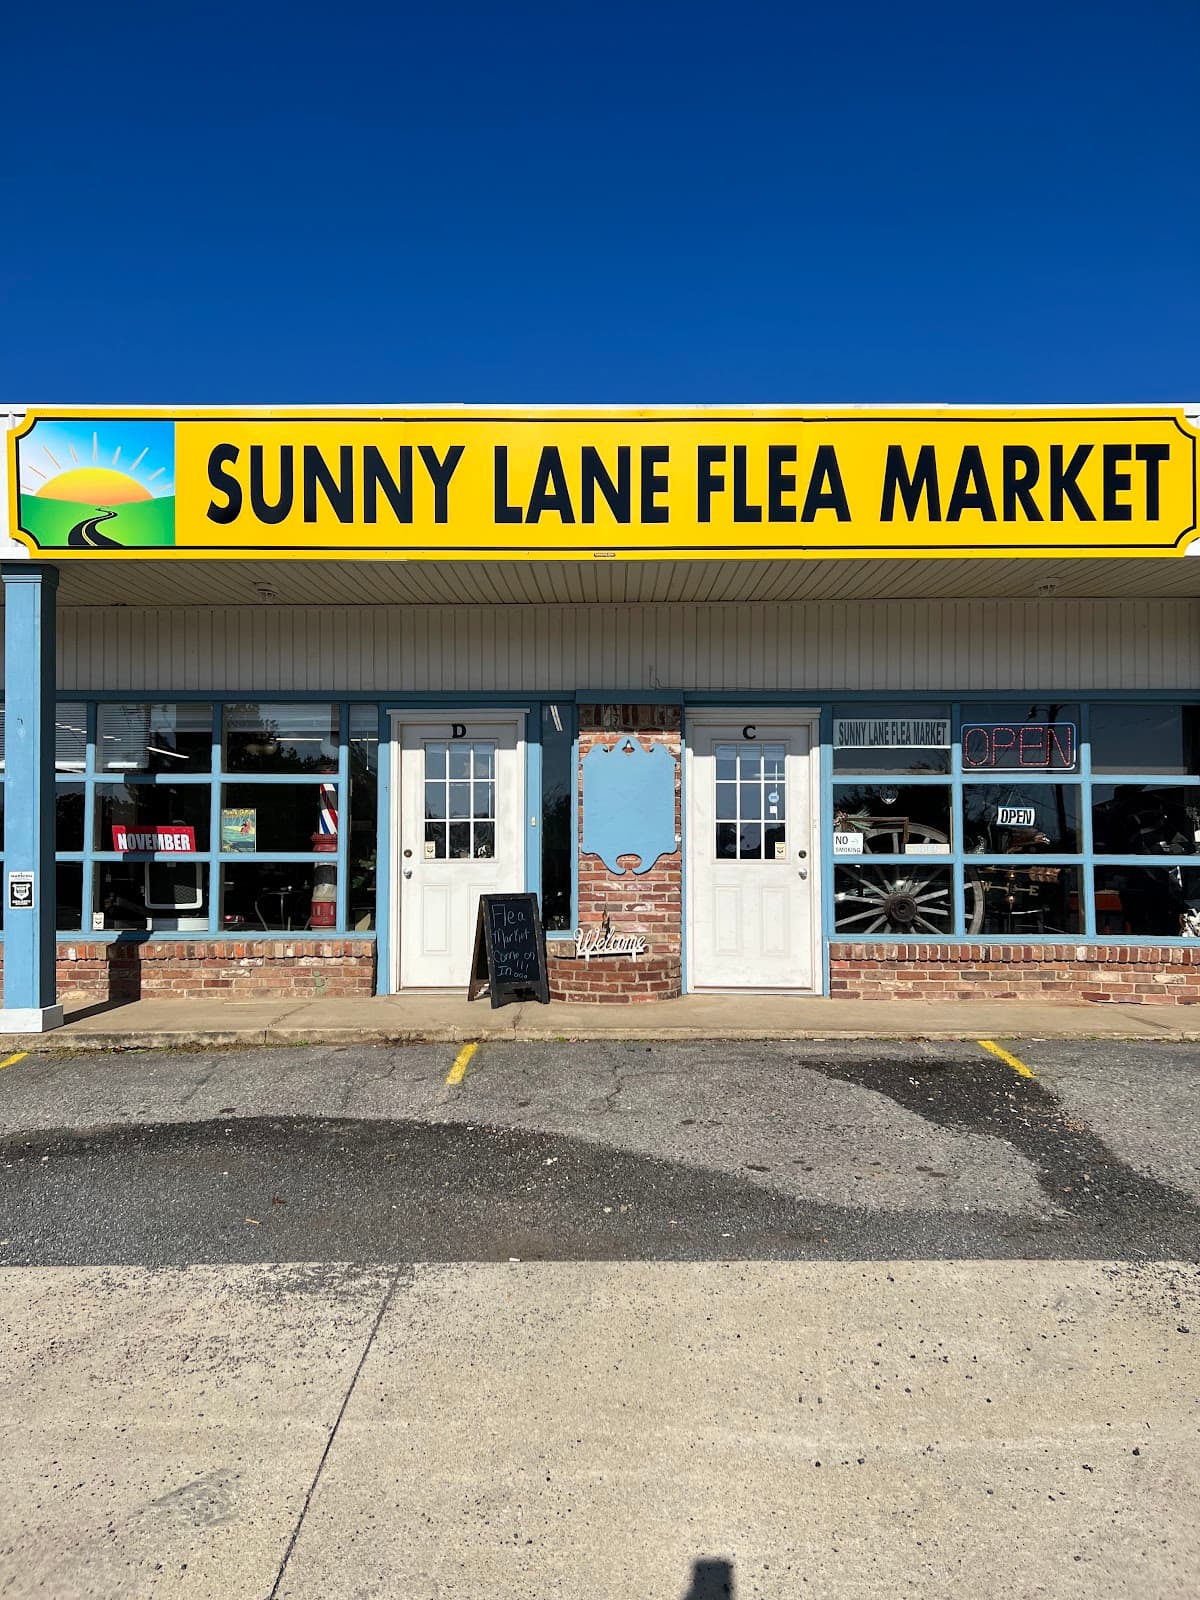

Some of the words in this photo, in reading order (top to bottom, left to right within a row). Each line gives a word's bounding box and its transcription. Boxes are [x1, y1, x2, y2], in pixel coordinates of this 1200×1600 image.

[207, 443, 465, 525] SUNNY
[494, 445, 670, 524] LANE
[697, 445, 852, 523] FLEA
[880, 443, 1170, 522] MARKET
[451, 723, 467, 739] D
[742, 725, 757, 740] C
[838, 721, 866, 746] SUNNY
[868, 721, 890, 746] LANE
[891, 721, 912, 746] FLEA
[913, 721, 947, 746] MARKET
[965, 727, 1072, 766] OPEN
[1000, 808, 1032, 825] OPEN
[117, 832, 191, 851] NOVEMBER
[835, 835, 849, 845] NO
[491, 903, 526, 928] Flea
[574, 928, 649, 953] Welcome
[493, 950, 520, 963] Come
